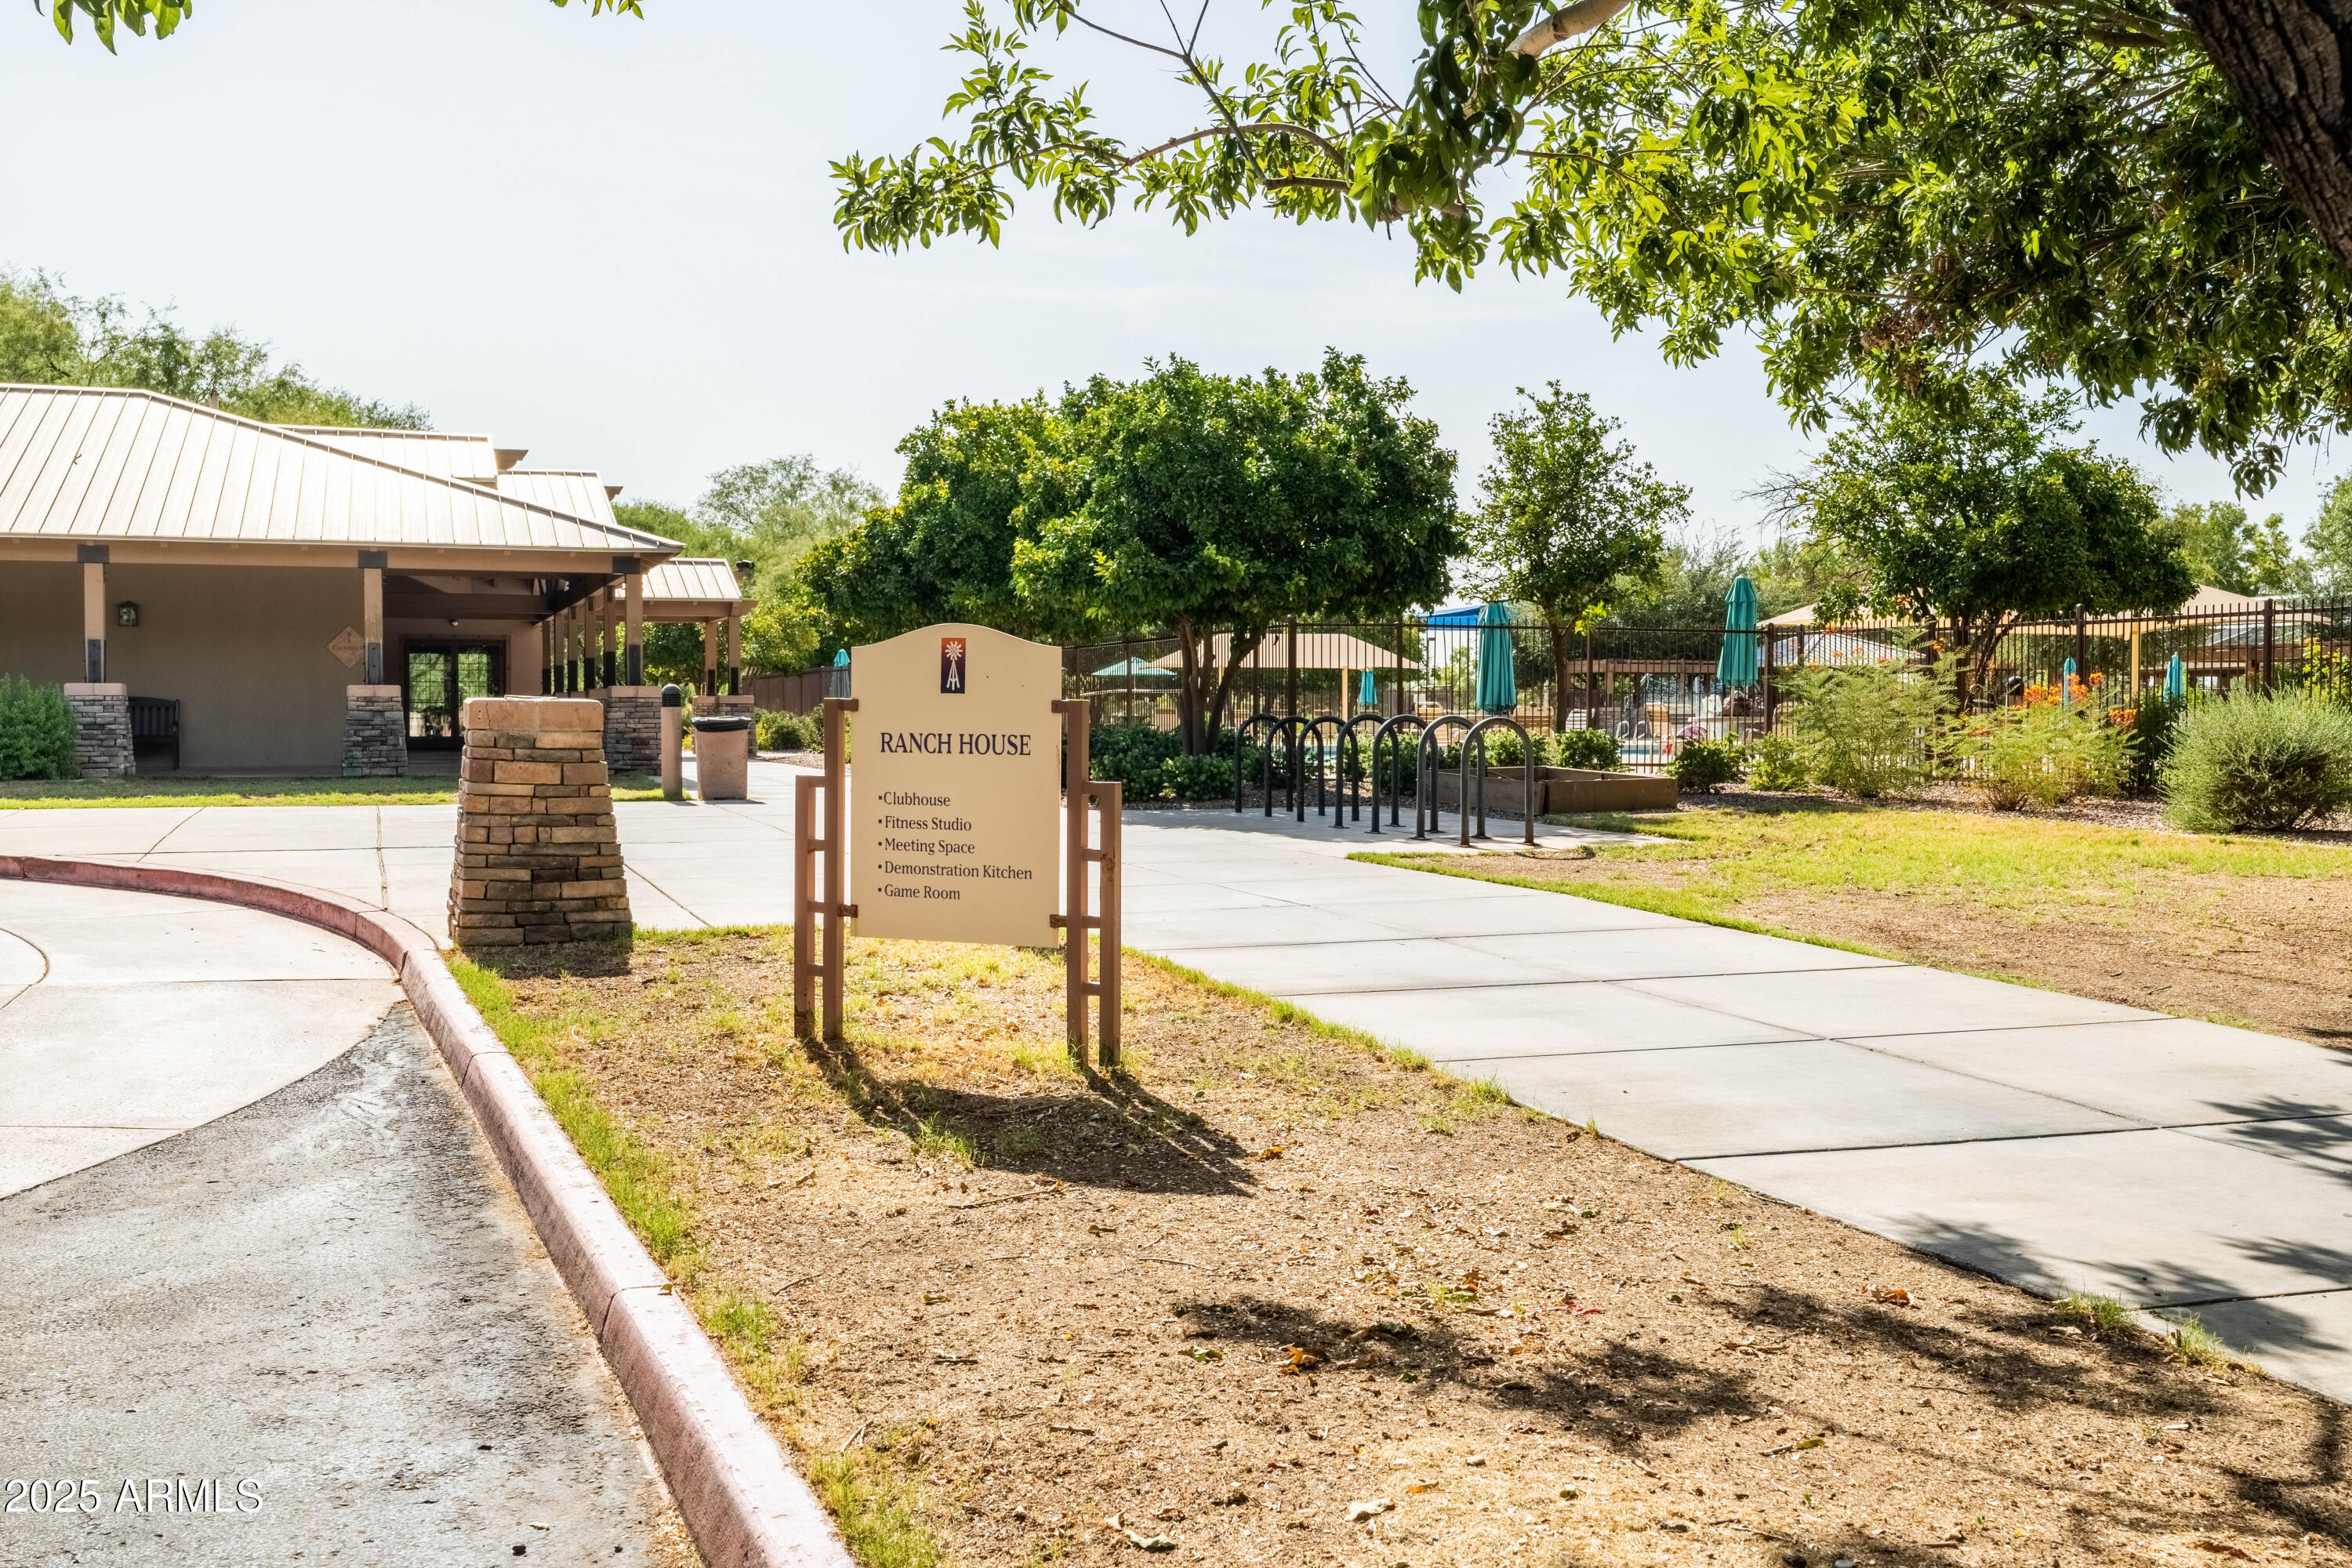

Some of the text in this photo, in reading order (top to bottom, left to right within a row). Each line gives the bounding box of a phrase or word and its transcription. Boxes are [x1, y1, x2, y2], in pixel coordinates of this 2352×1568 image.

[880, 732, 1031, 756] RANCH HOUSE
[884, 792, 950, 806] Clubhouse
[885, 815, 971, 831] Fitness Studio
[885, 838, 975, 856] Meeting Space
[885, 861, 1033, 880] Demonstration Kitchen
[884, 884, 960, 900] Game Room
